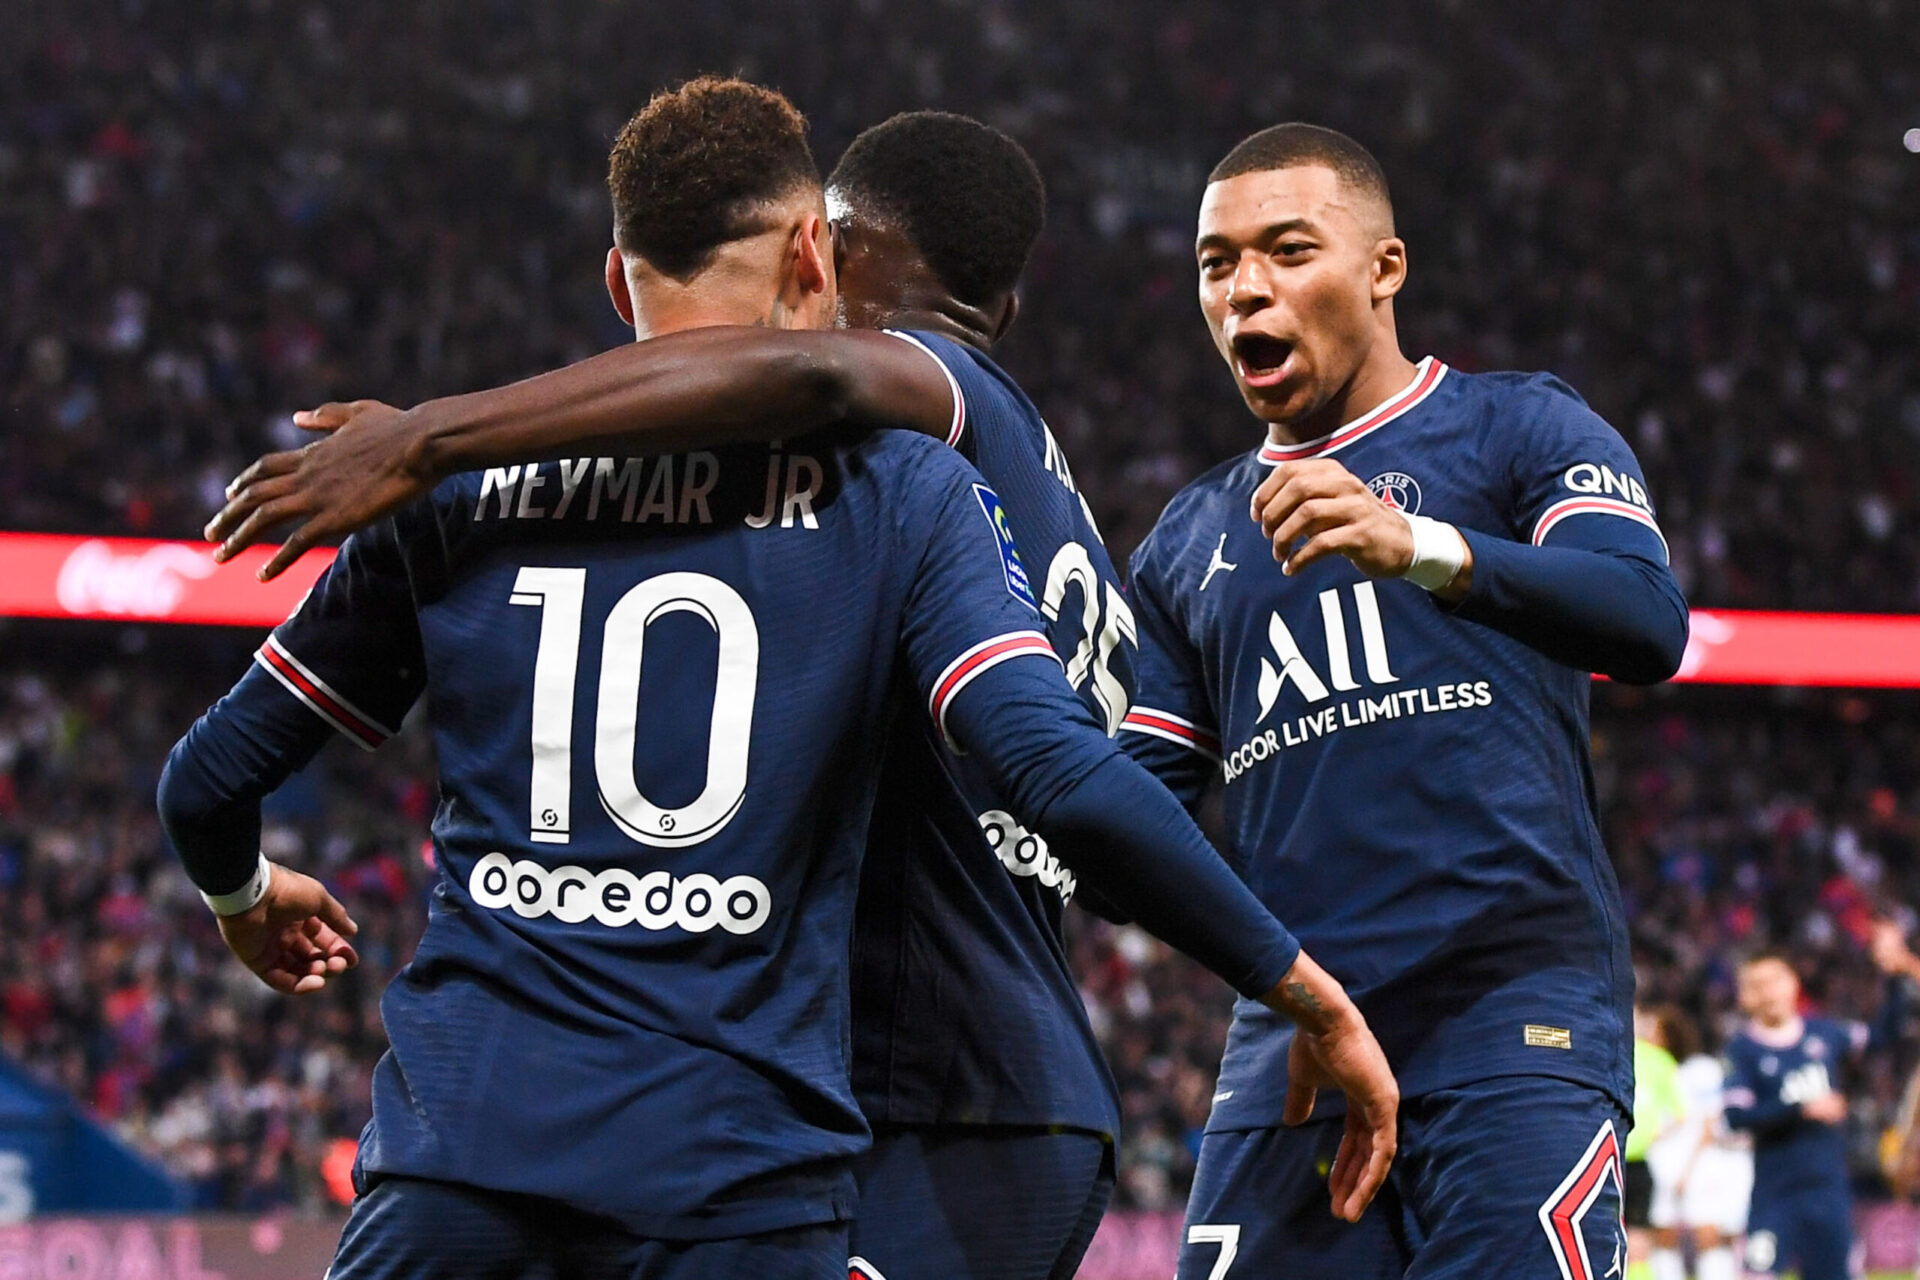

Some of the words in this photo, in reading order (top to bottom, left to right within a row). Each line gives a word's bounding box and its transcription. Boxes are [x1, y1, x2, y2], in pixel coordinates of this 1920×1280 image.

[473, 451, 721, 524] NEYMAR
[508, 566, 761, 848] 10
[1222, 729, 1281, 785] ACCOR
[1282, 706, 1338, 747] LIVE
[1341, 681, 1493, 727] LIMITLESS
[474, 857, 767, 929] ooredoo
[1187, 1224, 1241, 1280] 7
